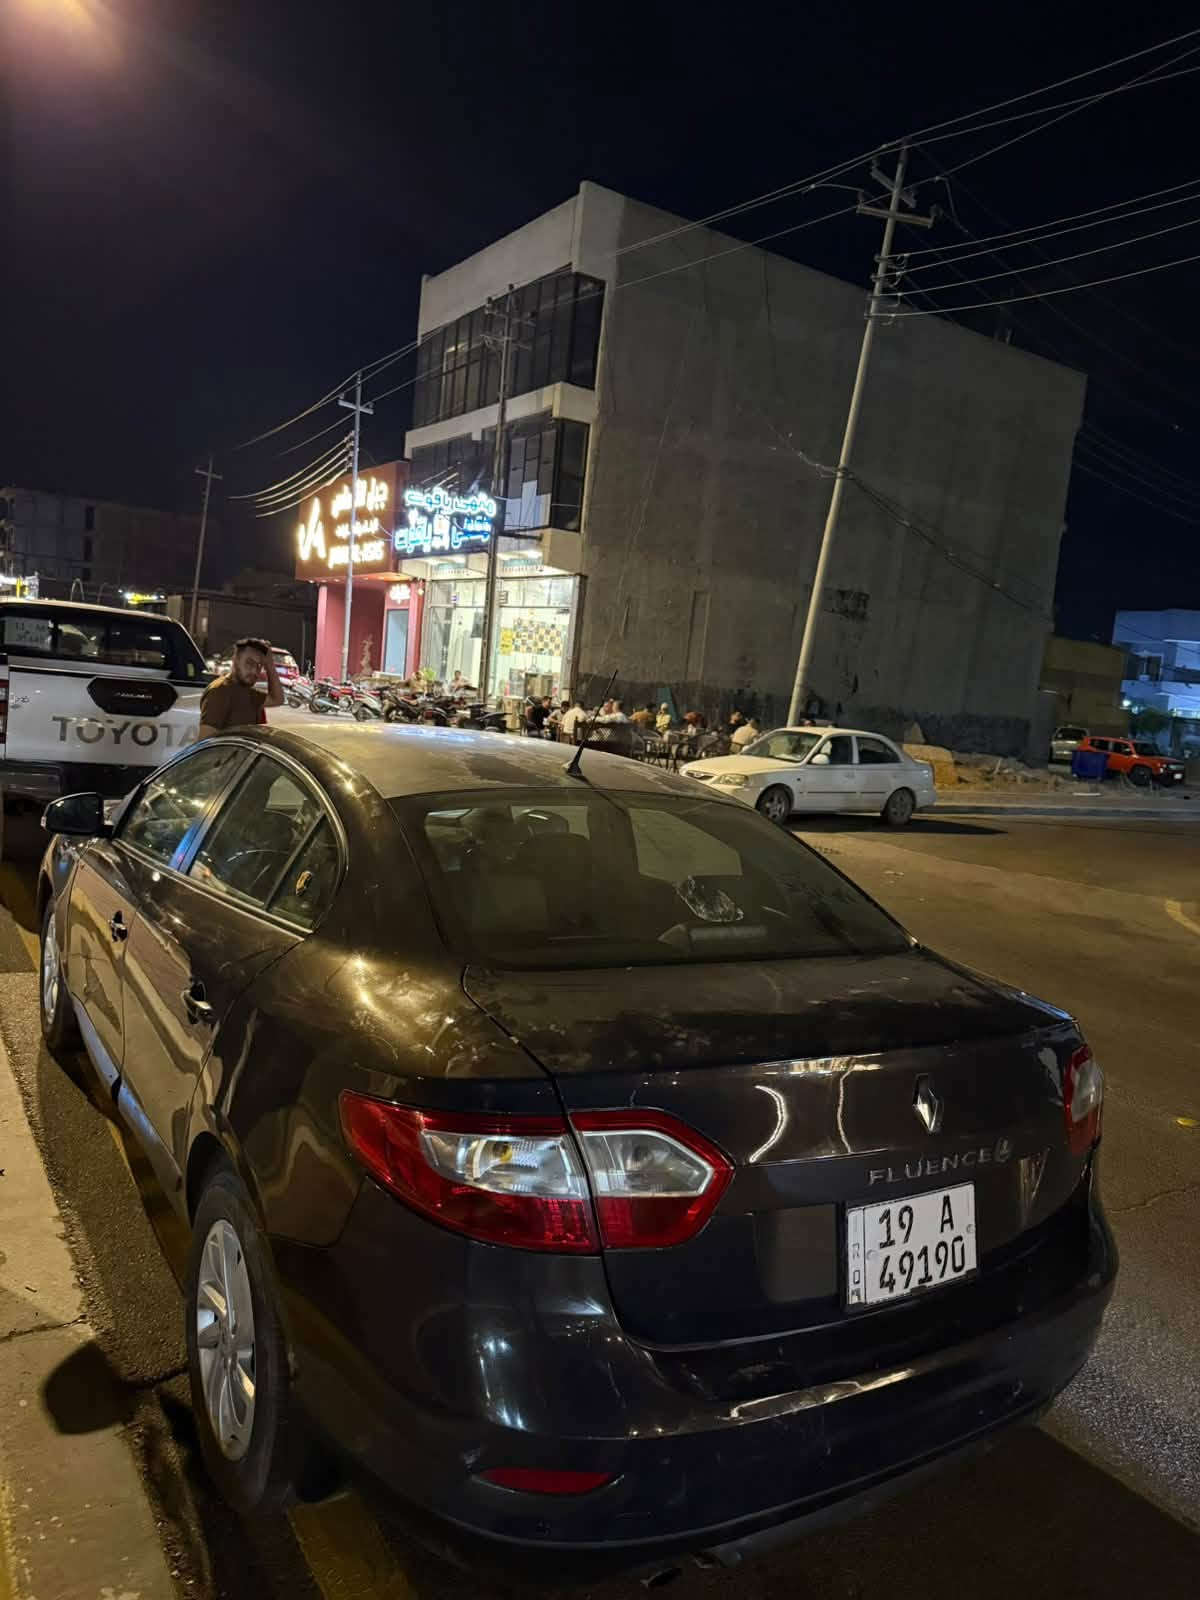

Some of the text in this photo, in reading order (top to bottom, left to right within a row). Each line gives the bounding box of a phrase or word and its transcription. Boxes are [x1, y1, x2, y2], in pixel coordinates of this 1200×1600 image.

[868, 1148, 992, 1185] FLUENCE
[879, 1194, 955, 1249] 19 A
[879, 1234, 966, 1294] 49190
